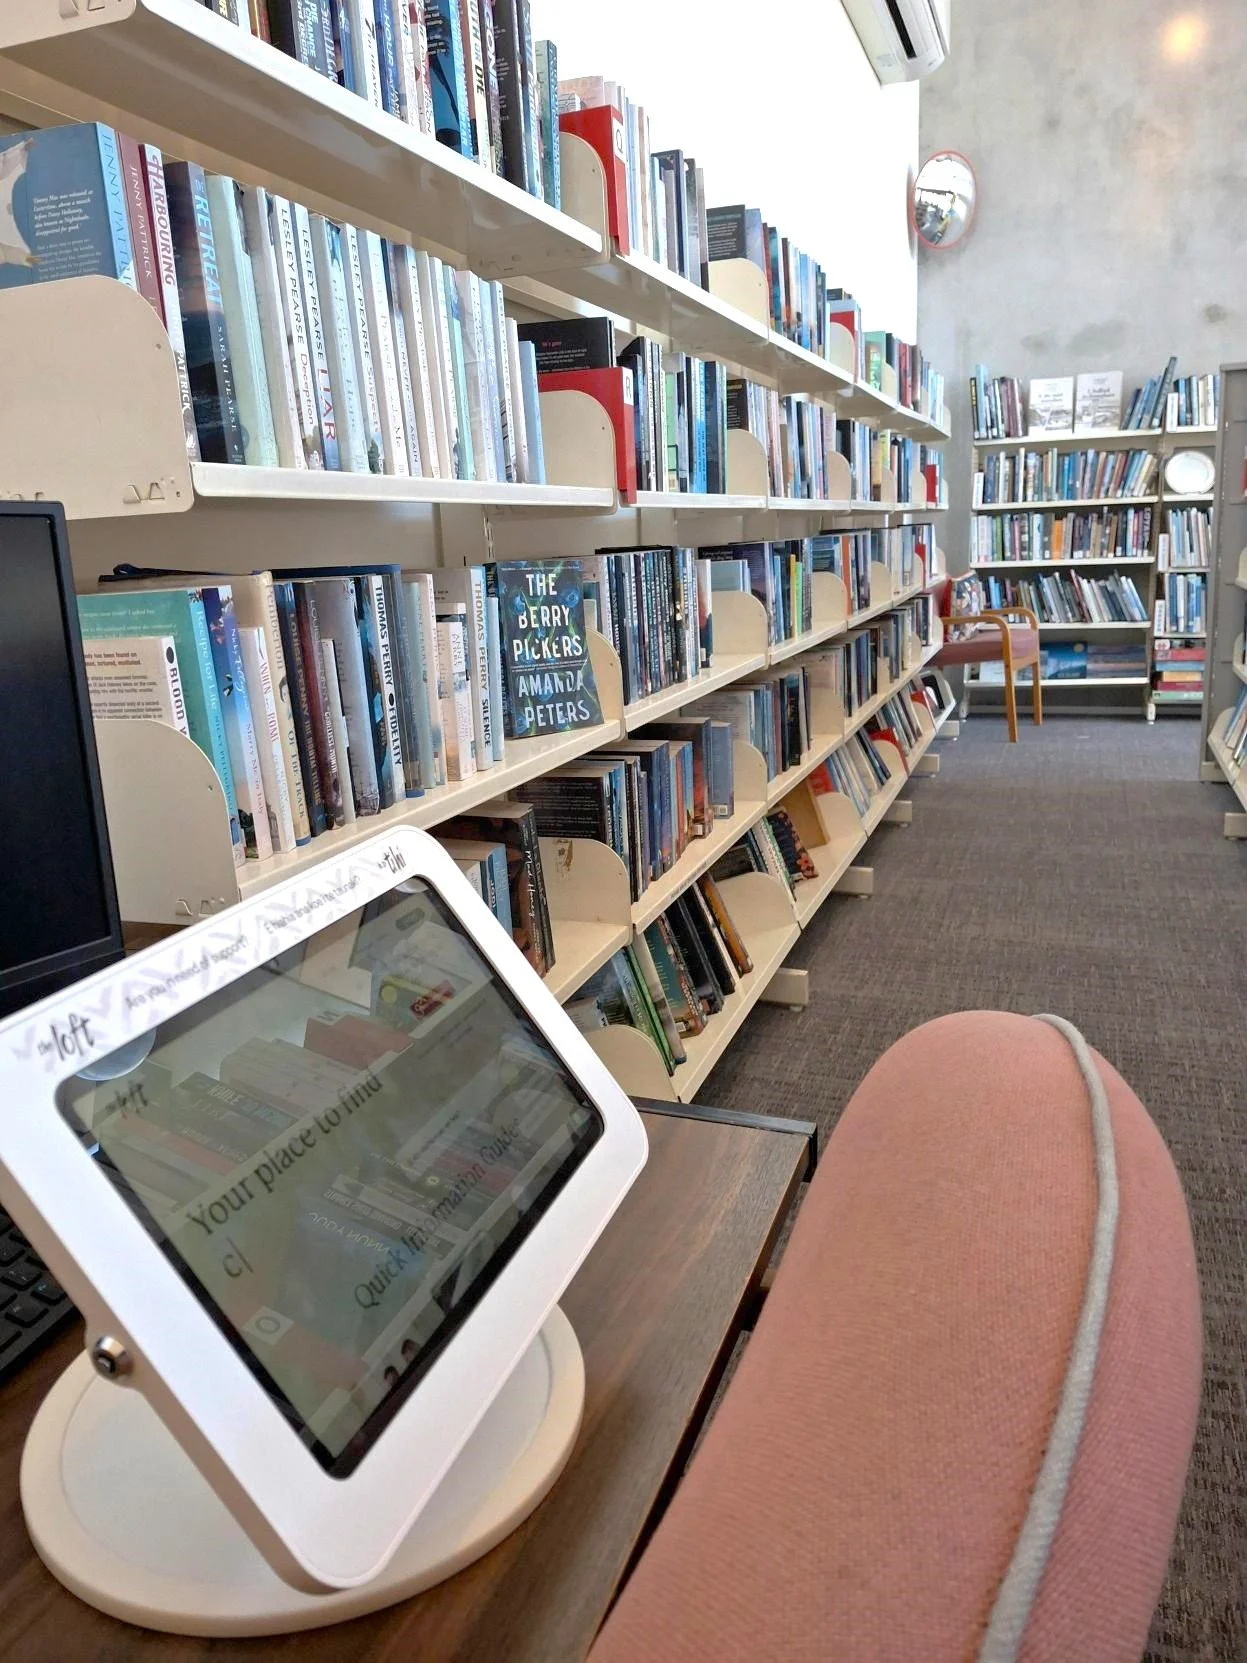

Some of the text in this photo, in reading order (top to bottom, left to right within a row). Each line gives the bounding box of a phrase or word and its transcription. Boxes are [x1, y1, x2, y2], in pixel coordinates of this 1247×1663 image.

[102, 134, 121, 198] JENNY
[130, 163, 152, 280] JENNY PATTRICK
[147, 154, 176, 286] HARBOURING
[281, 208, 315, 426] LESLEY PEARSE Deception
[302, 228, 316, 290] LESLEY
[310, 295, 324, 361] PEARSE
[350, 234, 362, 290] LESLEY
[358, 297, 371, 357] PEARSE
[176, 350, 192, 414] PATTRICK
[217, 325, 238, 432] SARAH PEARSE
[518, 604, 570, 629] BERRY
[526, 572, 558, 597] THE
[197, 608, 211, 659] Recipe
[289, 612, 303, 667] LOUISE
[298, 670, 311, 715] PENNY
[474, 582, 492, 747] THOMAS PERRY SILENCE
[513, 636, 583, 662] PICKERS
[375, 585, 403, 766] THOMAS PERRY FIDELITY
[518, 670, 584, 698] AMANDA
[524, 700, 590, 729] PETERS
[49, 1012, 97, 1064] loft
[187, 1180, 254, 1236] Your
[254, 1131, 317, 1195] place
[317, 1105, 341, 1135] to
[336, 1070, 385, 1116] find
[353, 1251, 410, 1312] Quick
